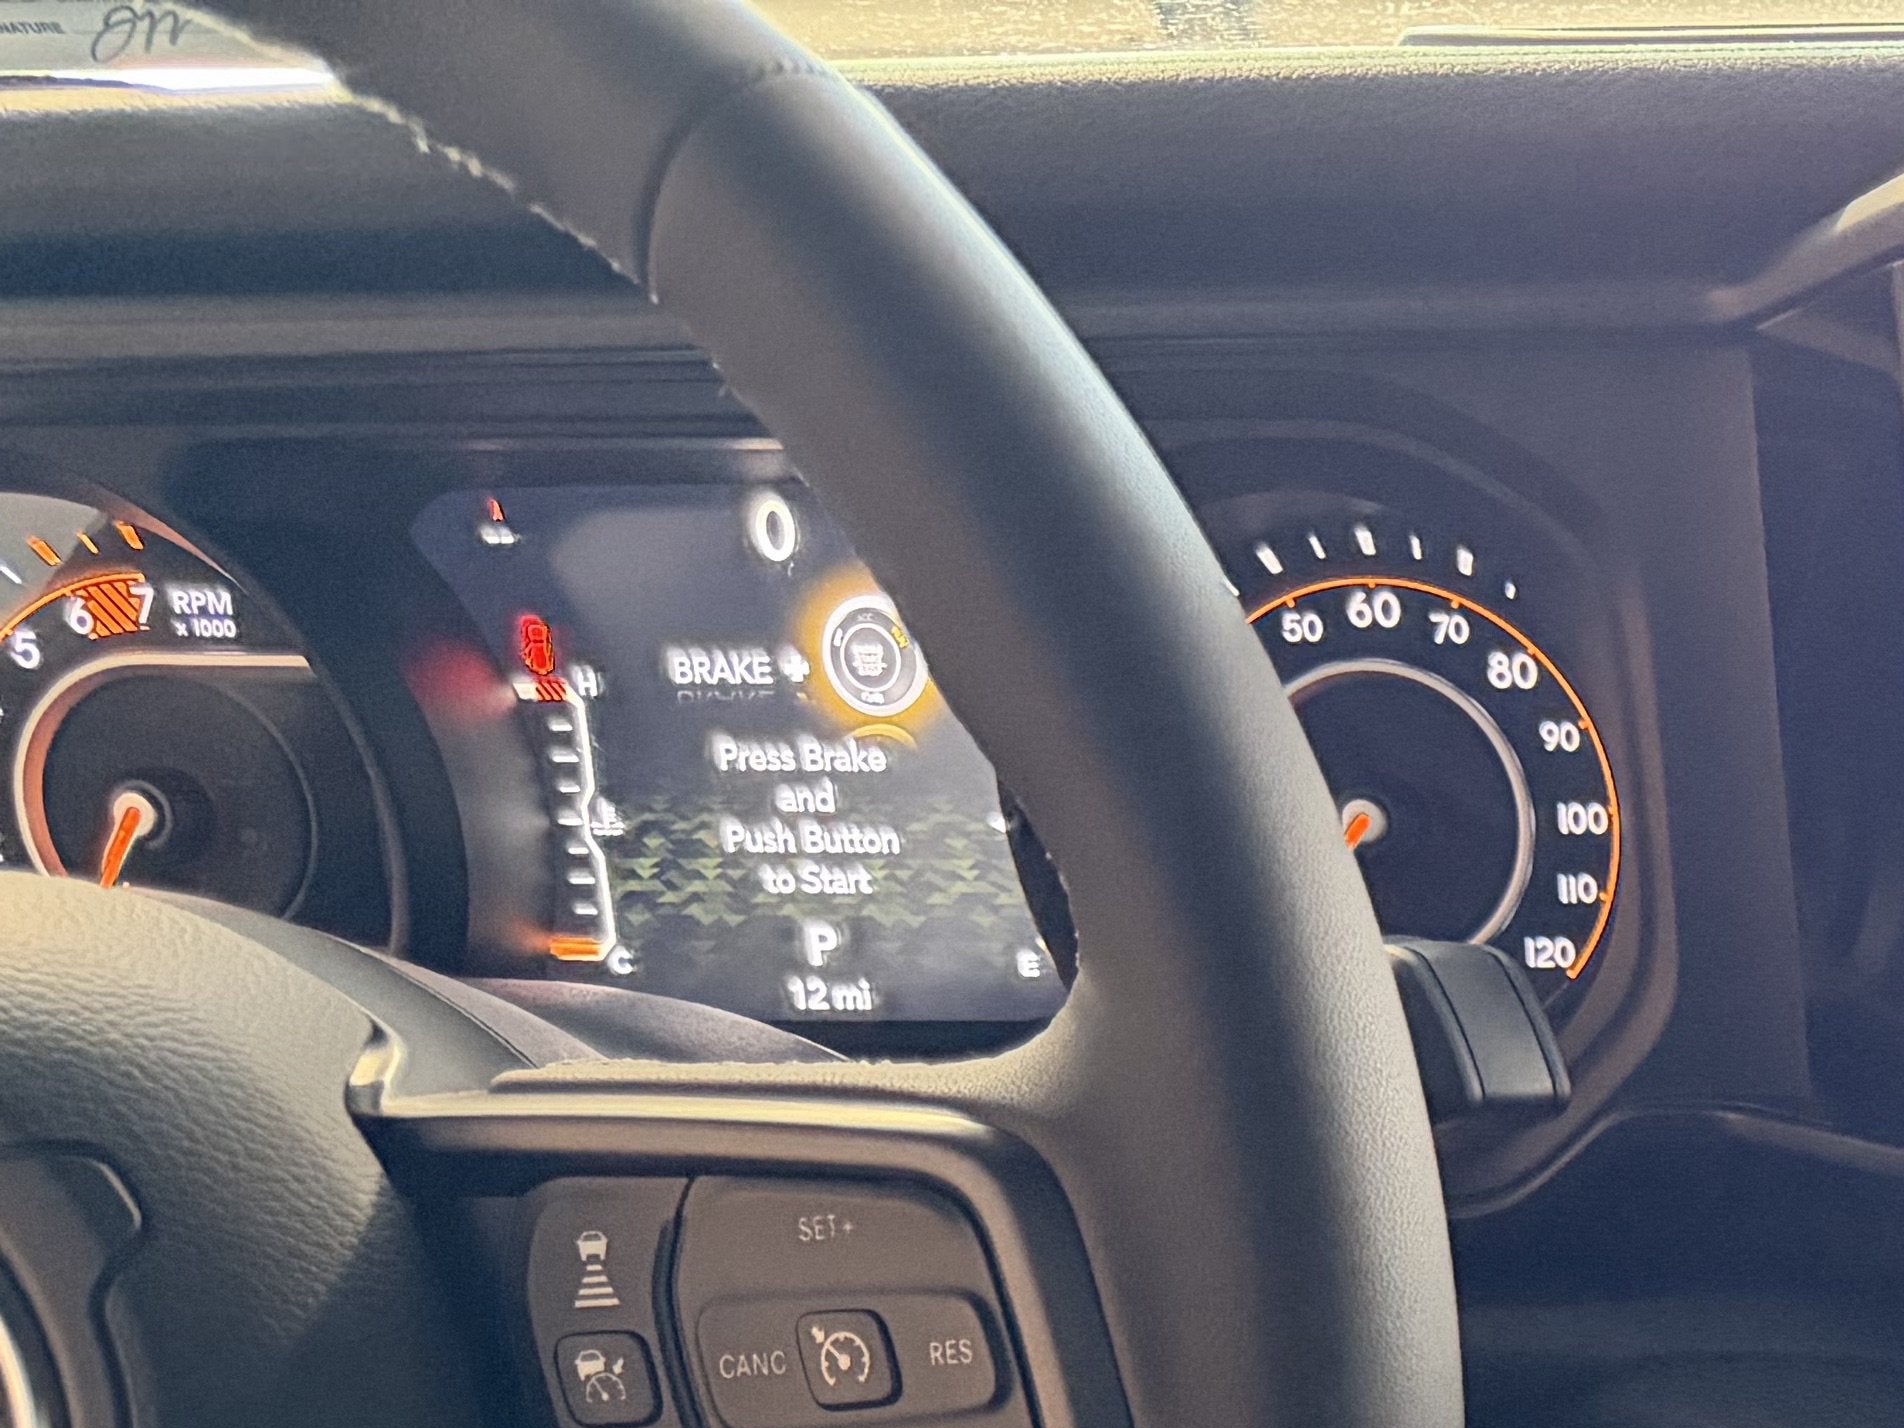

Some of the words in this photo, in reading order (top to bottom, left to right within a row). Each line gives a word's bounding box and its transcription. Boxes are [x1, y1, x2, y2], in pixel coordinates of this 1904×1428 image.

[752, 493, 796, 562] 0
[69, 595, 95, 635] 6
[129, 585, 154, 625] 7
[172, 589, 234, 616] RPM
[1347, 592, 1401, 629] 60
[193, 618, 238, 639] 1000
[1281, 612, 1324, 644] 50
[1429, 613, 1470, 645] 70
[9, 630, 41, 669] 5
[576, 664, 600, 698] H
[670, 651, 773, 687] BRAKE
[1487, 651, 1539, 690] 80
[1539, 720, 1580, 752] 90
[718, 740, 796, 774] Press
[801, 739, 887, 774] Brake
[774, 784, 836, 815] and
[1557, 802, 1608, 836] 100
[724, 825, 795, 856] Push
[800, 826, 900, 856] Button
[763, 866, 795, 895] to
[801, 865, 874, 896] Start
[1556, 872, 1598, 905] 110
[607, 947, 635, 975] C
[806, 924, 840, 968] P
[1524, 936, 1576, 969] 120
[1017, 949, 1041, 978] E
[792, 979, 828, 1012] 12
[831, 979, 874, 1011] mi
[718, 1350, 787, 1380] CANC
[929, 1340, 974, 1367] RES
